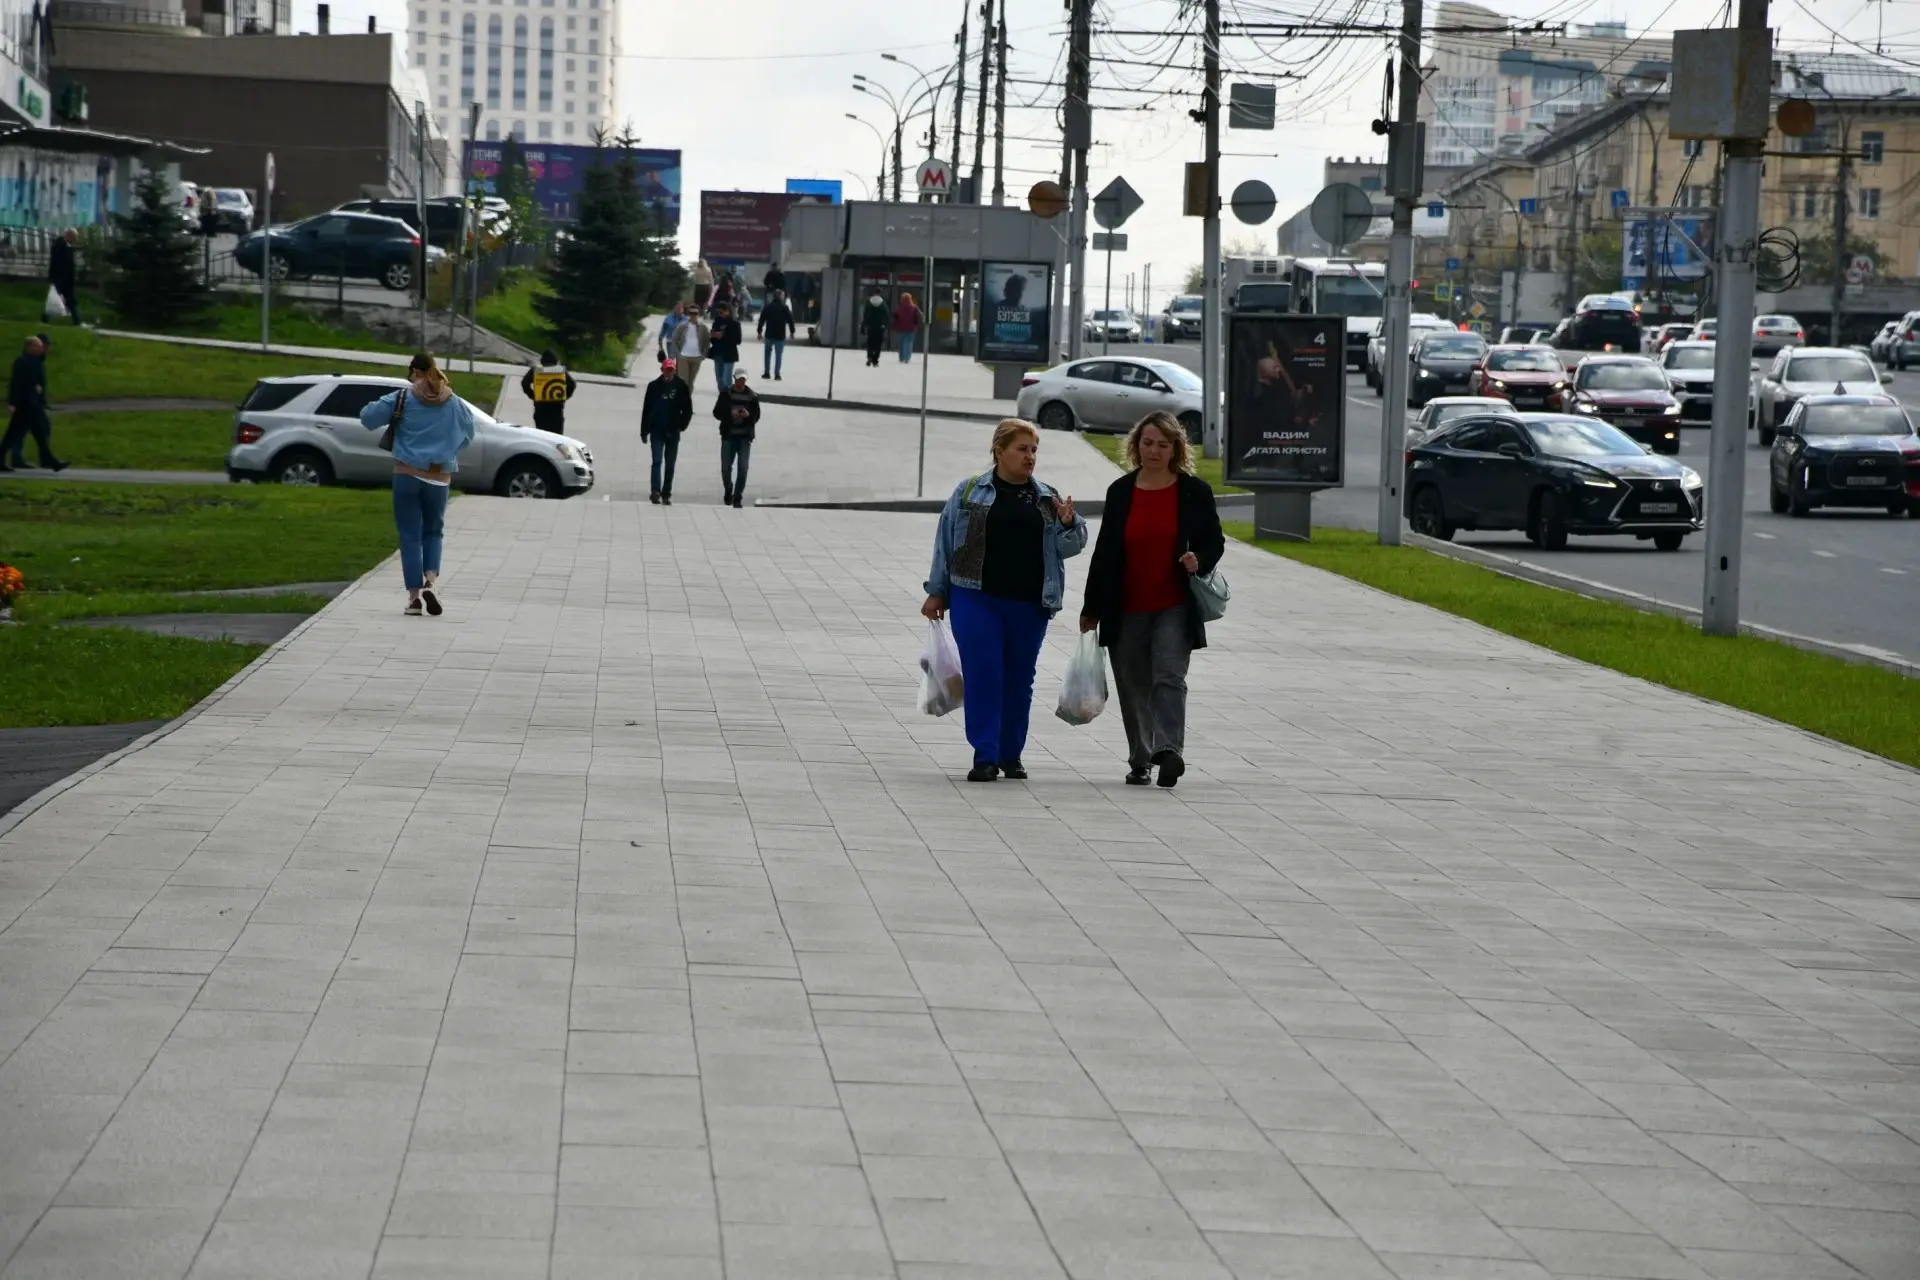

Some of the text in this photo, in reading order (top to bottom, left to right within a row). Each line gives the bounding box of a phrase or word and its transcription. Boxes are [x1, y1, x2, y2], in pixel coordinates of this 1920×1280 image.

[922, 168, 947, 188] М
[1313, 332, 1326, 345] 4
[1263, 431, 1309, 440] ВАДИМ
[1242, 447, 1327, 460] АГАТА КРИСТИ
